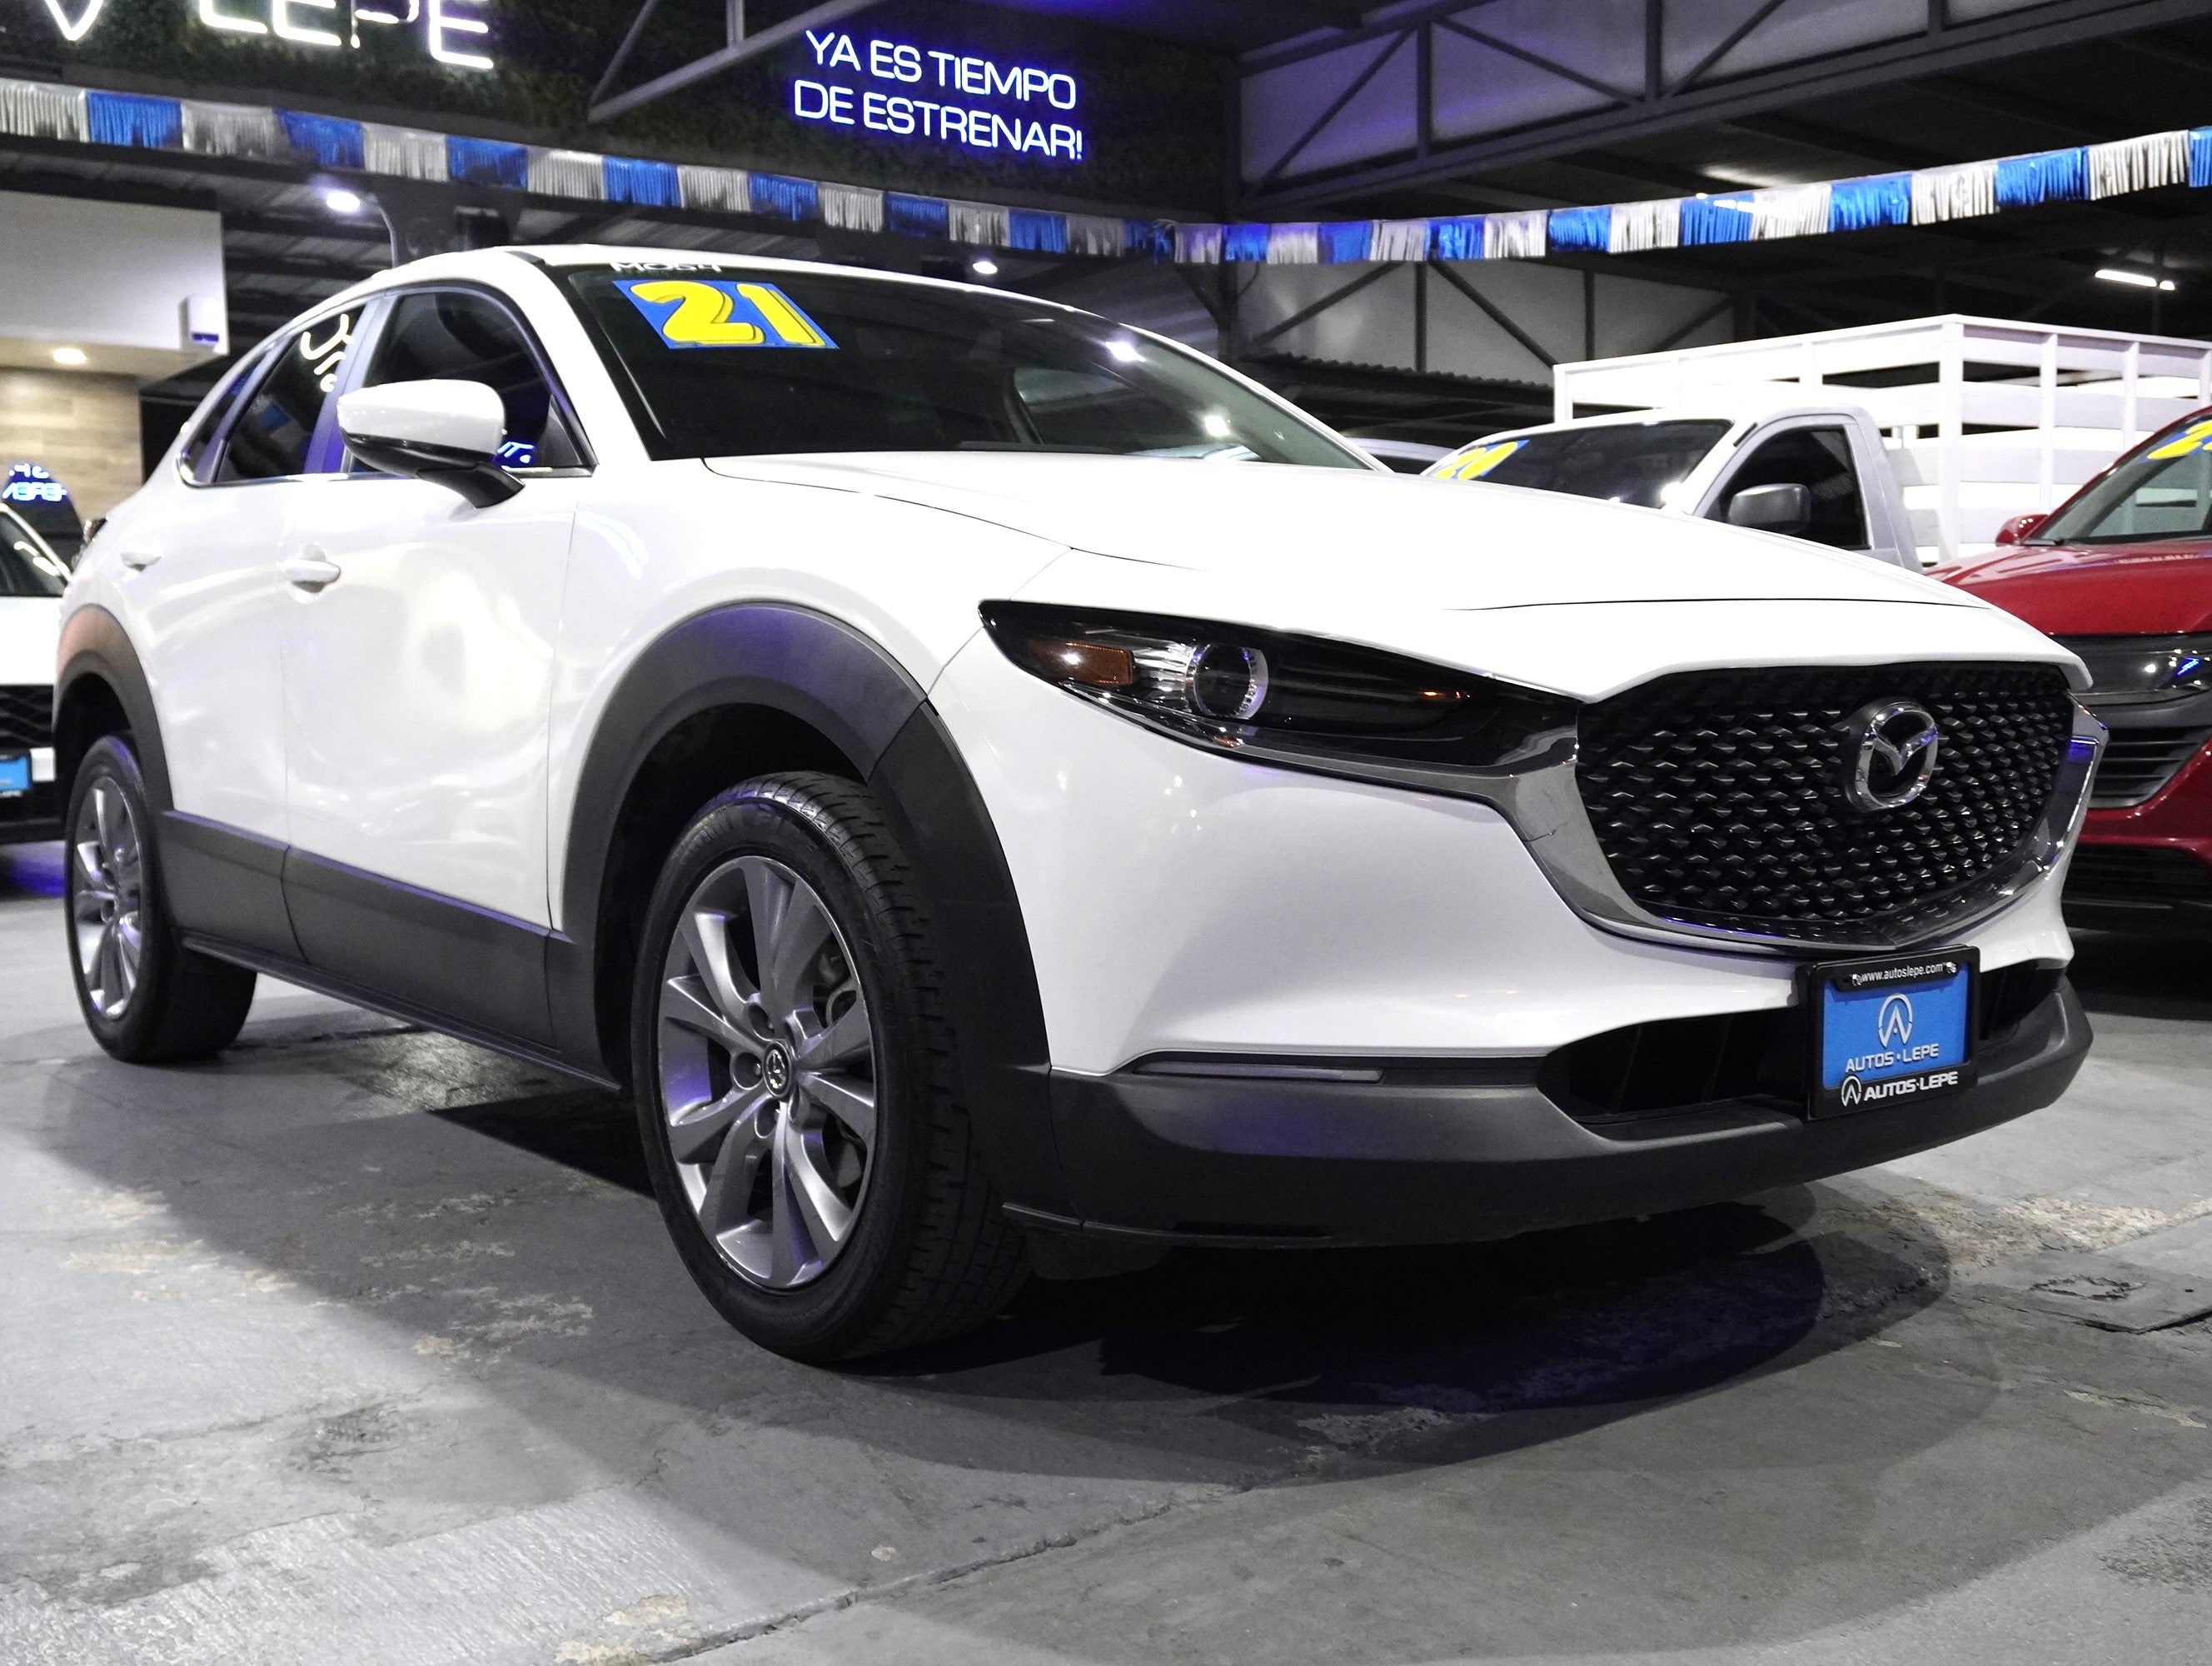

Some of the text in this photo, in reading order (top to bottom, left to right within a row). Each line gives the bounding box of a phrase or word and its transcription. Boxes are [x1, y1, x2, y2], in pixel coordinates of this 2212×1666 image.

[805, 30, 1076, 110] YA ES TIEMPO
[794, 79, 1083, 160] DE ESTRENAR!
[630, 280, 827, 347] 21
[1858, 963, 1944, 984] www.autoslepe.com
